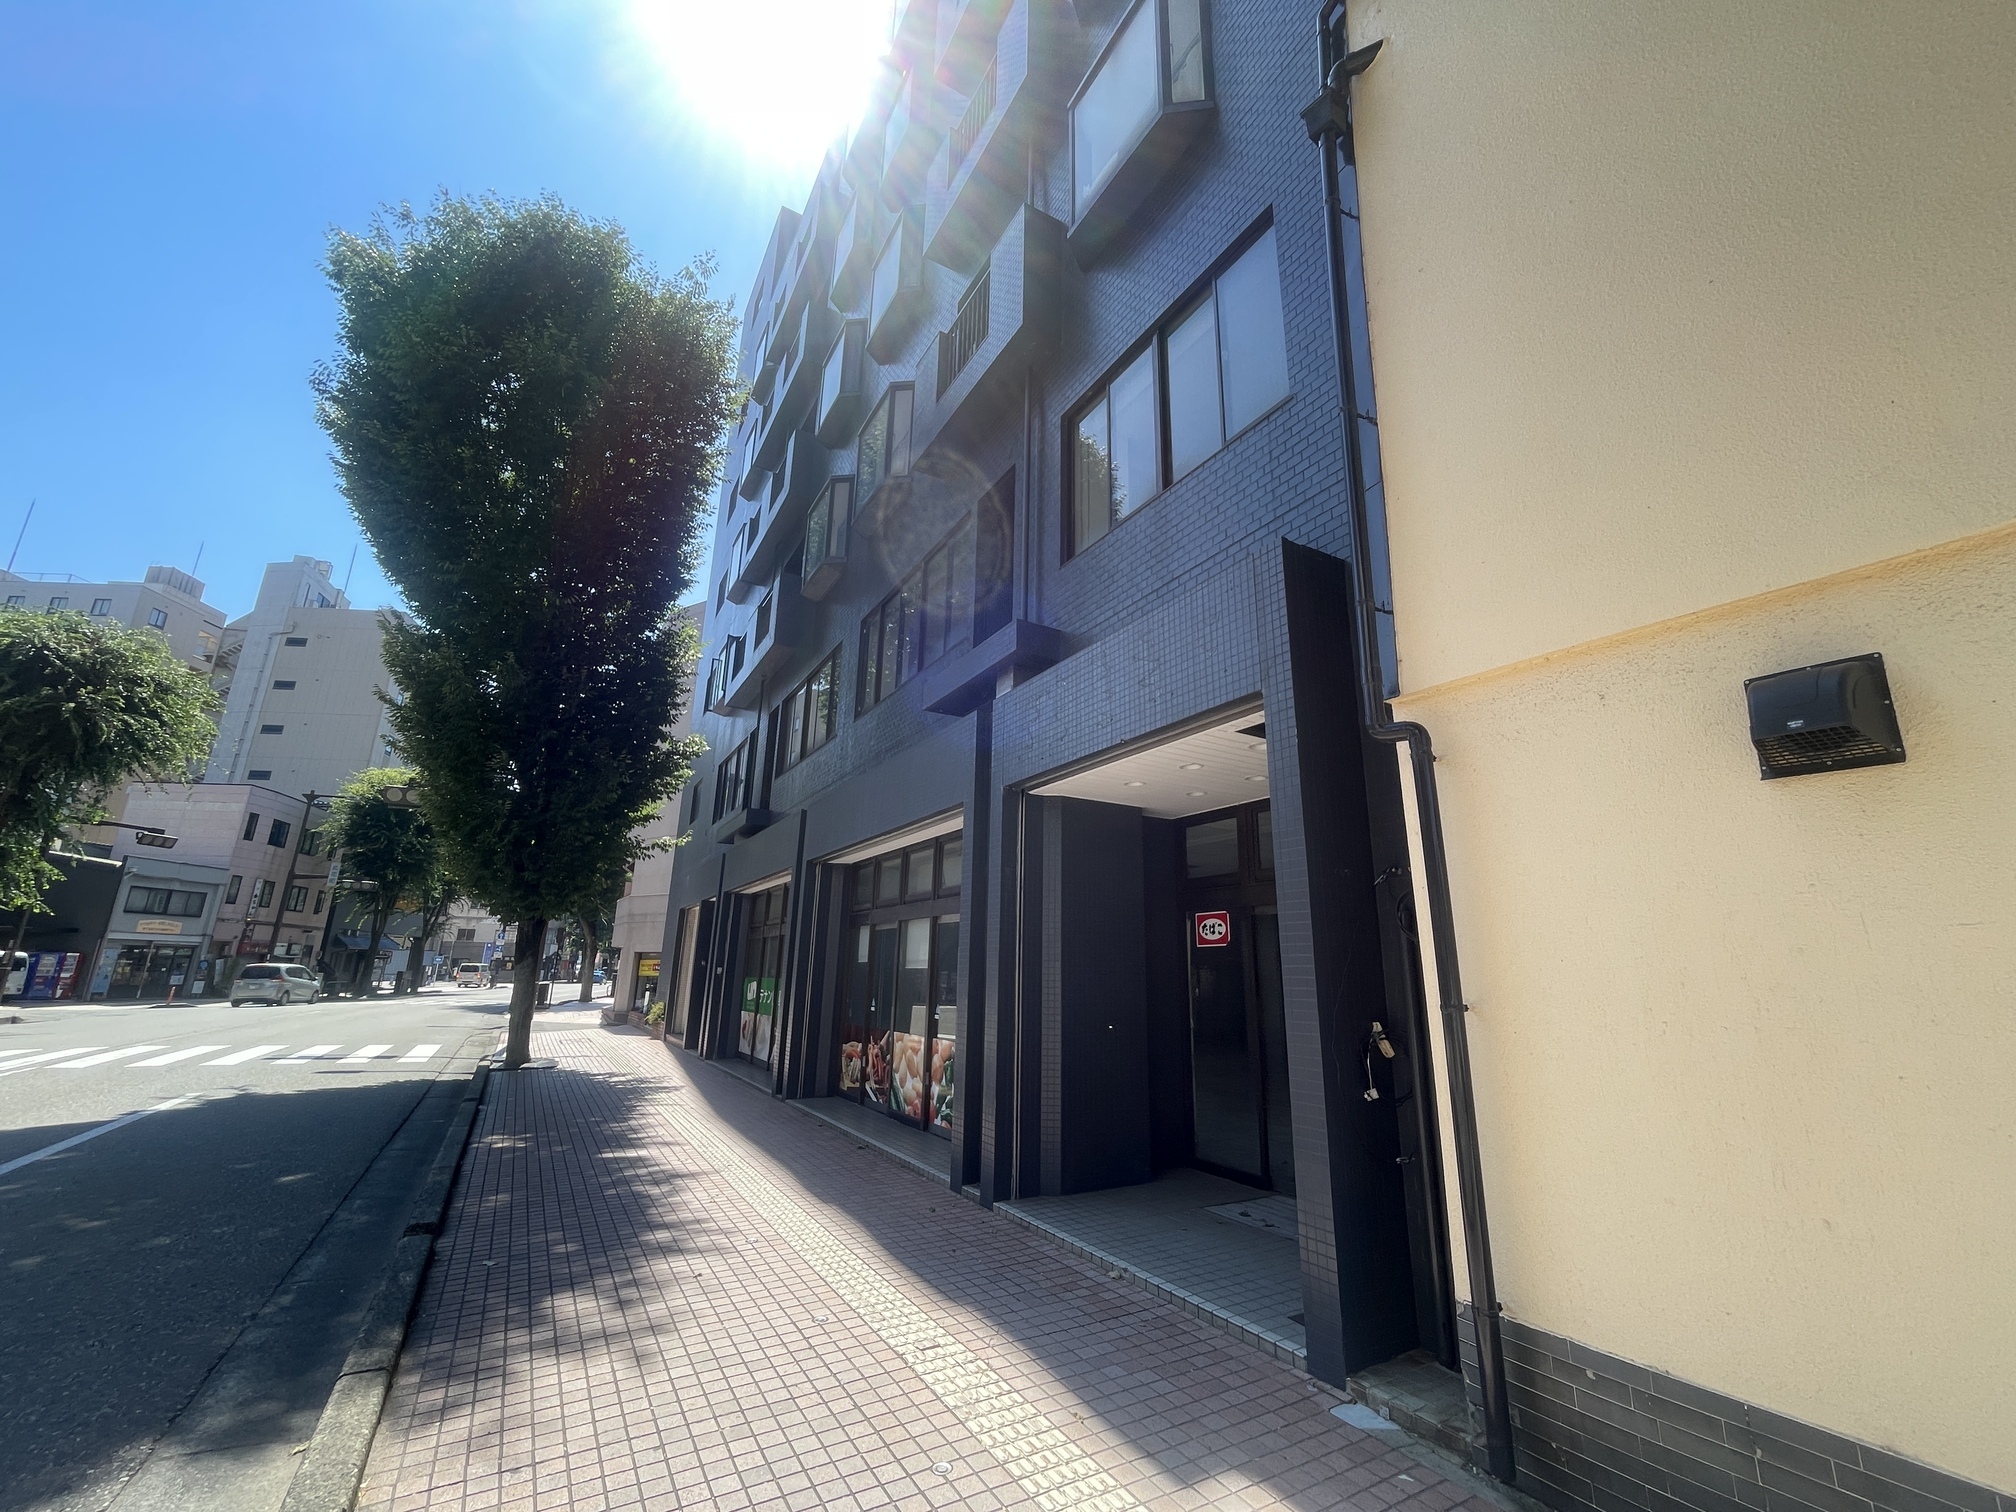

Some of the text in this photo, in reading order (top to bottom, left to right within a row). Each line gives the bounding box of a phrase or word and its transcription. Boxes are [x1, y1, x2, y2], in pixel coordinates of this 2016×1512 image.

[1201, 922, 1223, 936] たばこ
[759, 989, 774, 1004] テナン
